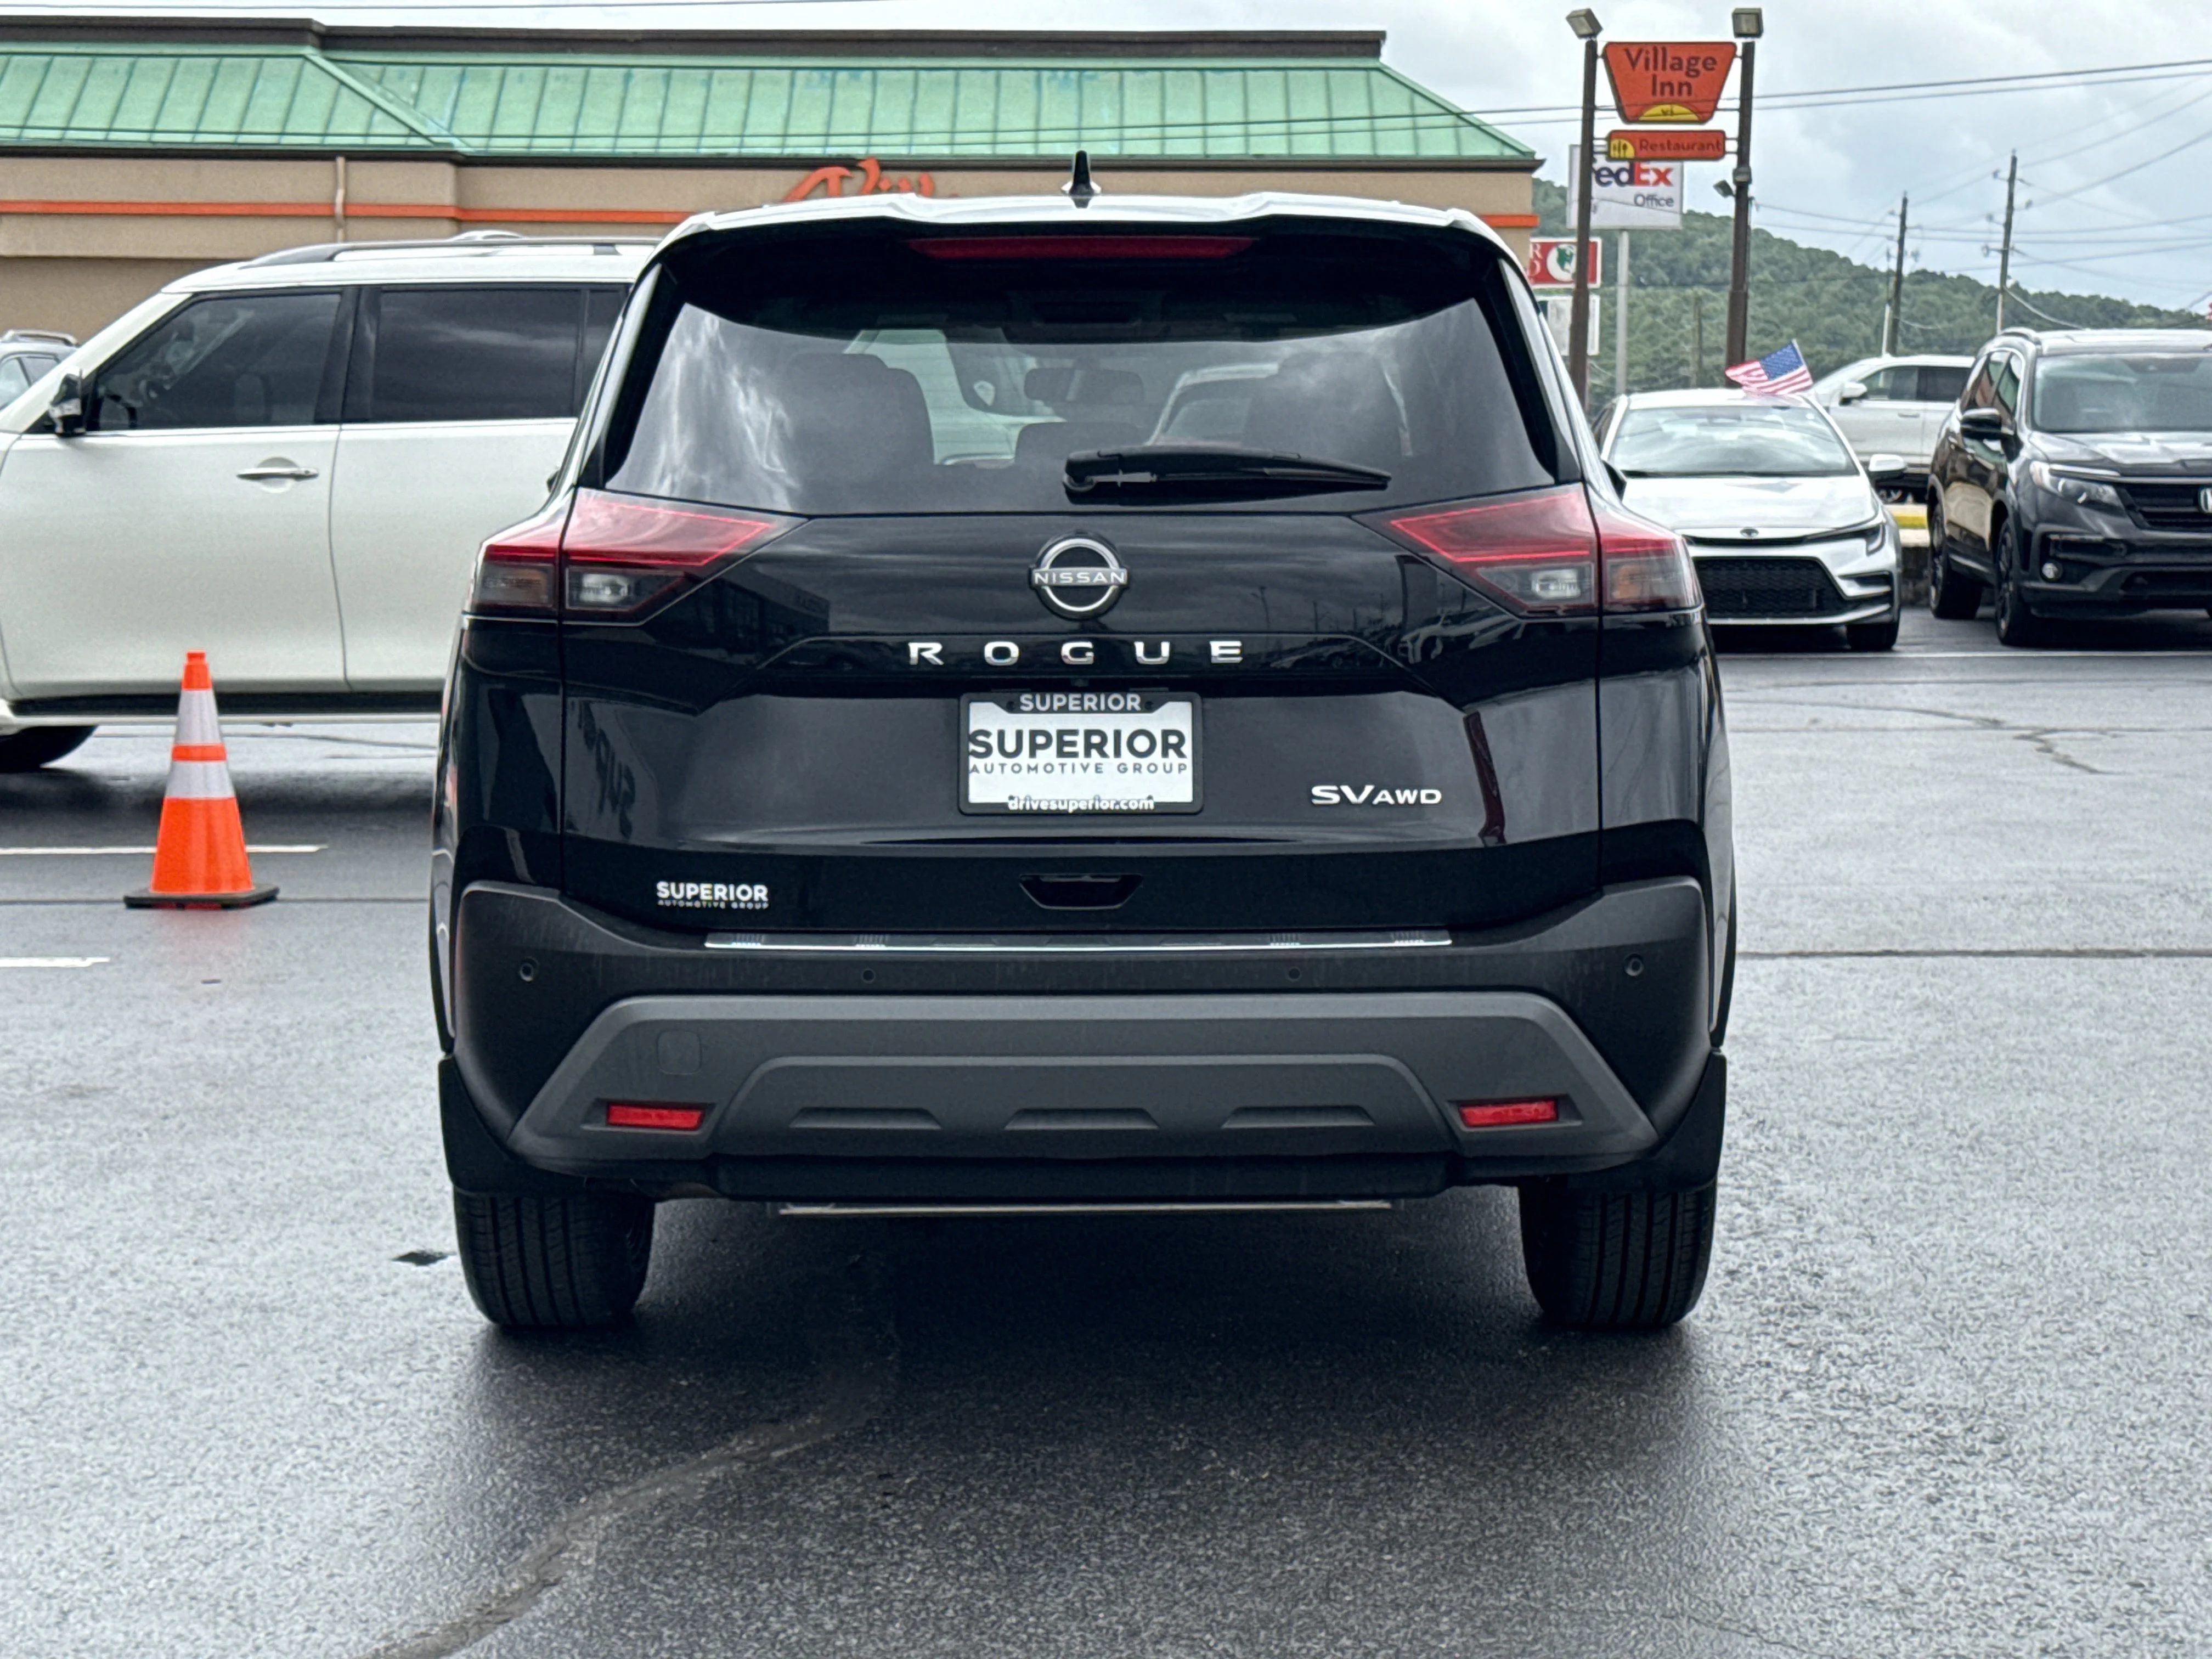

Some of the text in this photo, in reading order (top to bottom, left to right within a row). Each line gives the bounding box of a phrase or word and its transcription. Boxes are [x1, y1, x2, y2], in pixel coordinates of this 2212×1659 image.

[1624, 46, 1717, 78] Village
[1651, 73, 1693, 97] Inn
[1639, 138, 1722, 153] Restaurant
[1592, 161, 1674, 187] edEx
[1634, 193, 1674, 207] Office
[1034, 571, 1125, 584] NISSAN
[908, 641, 1244, 666] ROGUE
[1019, 693, 1142, 712] SUPERIOR
[968, 729, 1187, 759] SUPERIOR
[969, 762, 1188, 775] AUTOMOTIVE GROUP
[1008, 795, 1155, 813] drivesuperior.com
[656, 881, 768, 902] SUPERIOR
